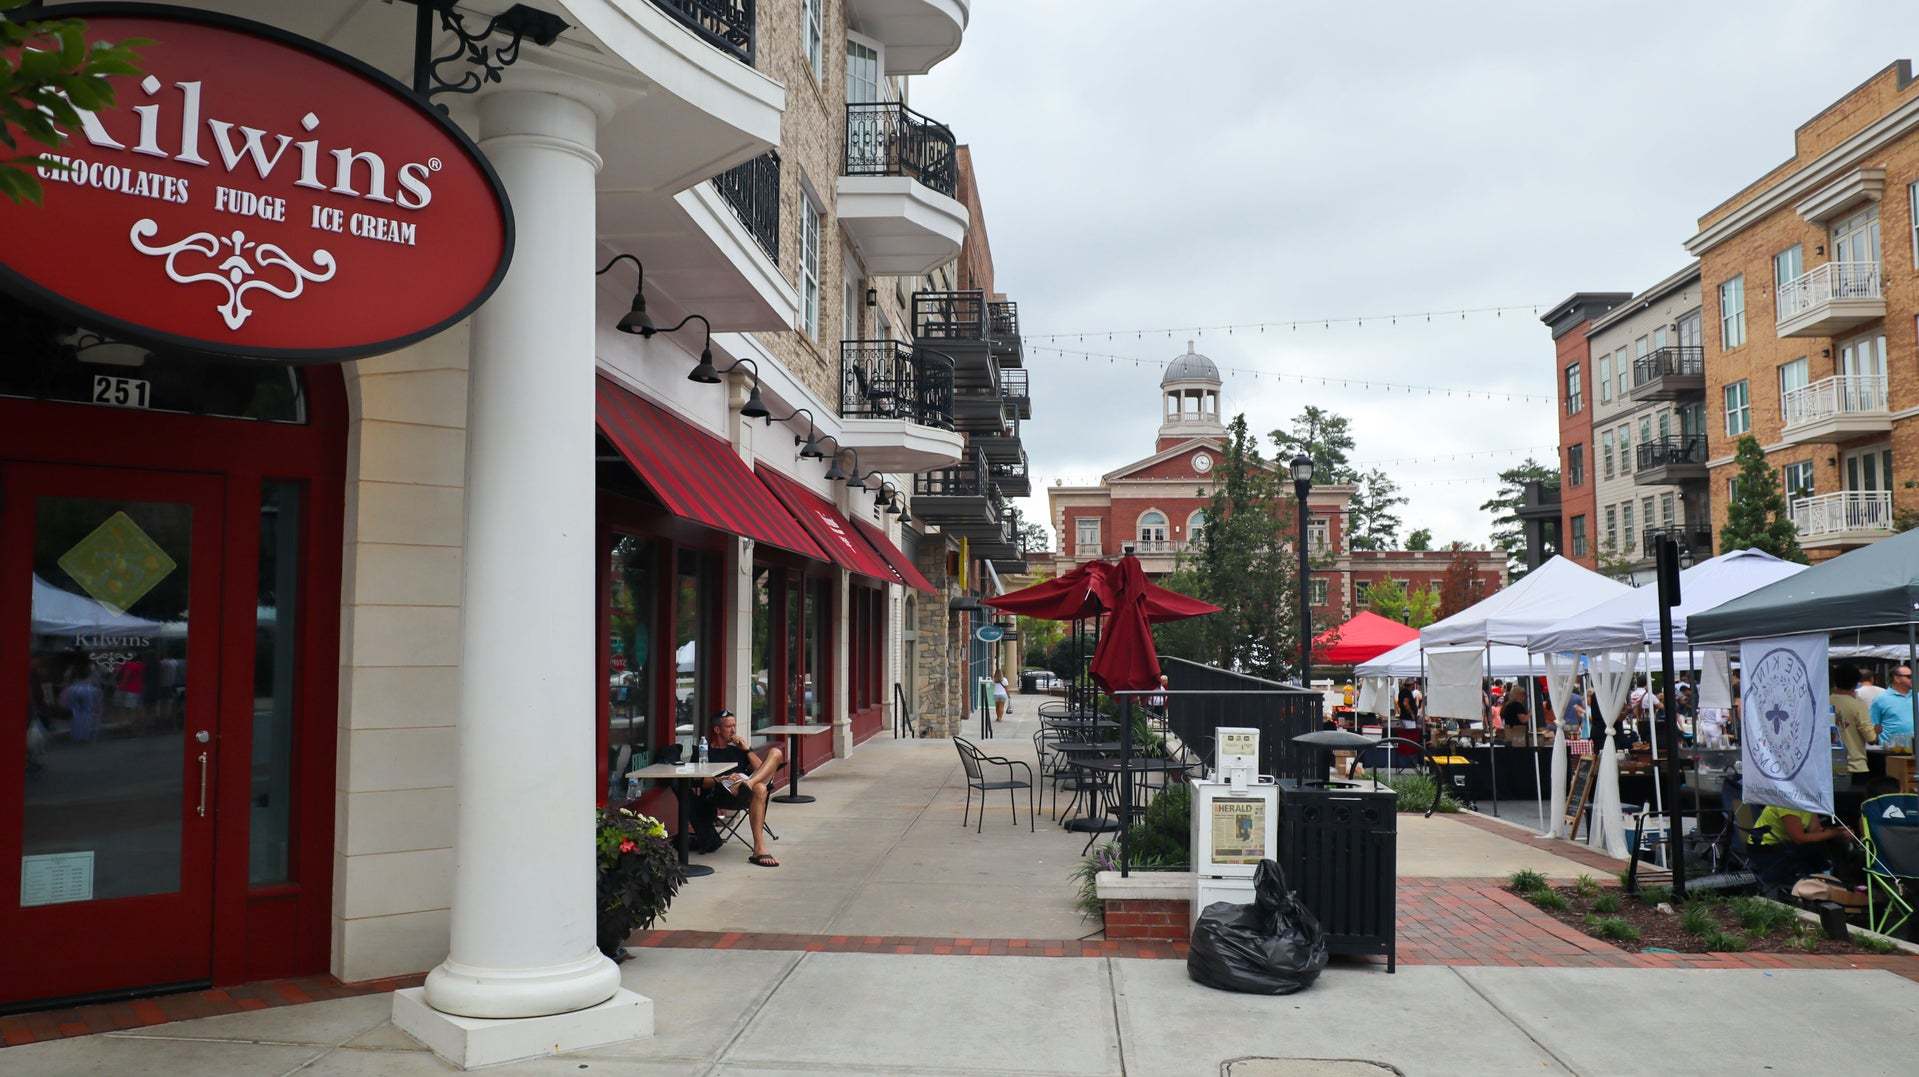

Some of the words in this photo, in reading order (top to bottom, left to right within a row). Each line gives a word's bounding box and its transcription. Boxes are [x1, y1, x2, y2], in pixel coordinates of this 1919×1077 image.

[37, 152, 189, 204] CHOCOLATES
[214, 186, 286, 222] FUDGE
[311, 205, 344, 232] ICE
[349, 213, 416, 246] CREAM
[95, 377, 147, 407] 251
[75, 632, 151, 647] Kilwins
[1218, 803, 1253, 813] HERALD
